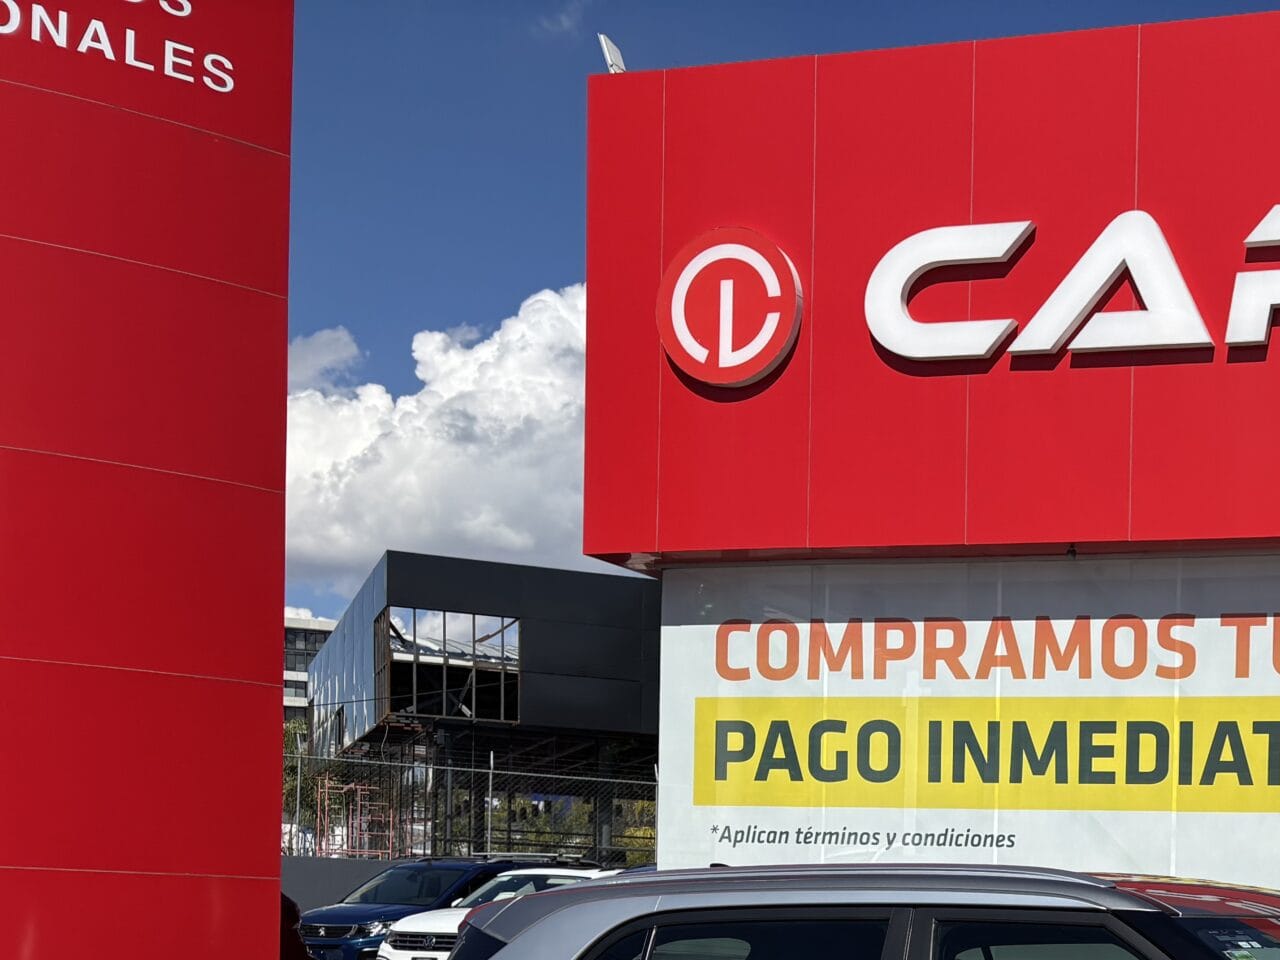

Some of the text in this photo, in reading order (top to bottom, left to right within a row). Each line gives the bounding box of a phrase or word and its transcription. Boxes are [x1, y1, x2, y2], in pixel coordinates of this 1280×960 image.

[714, 612, 1197, 682] COMPRAMOS
[714, 719, 901, 782] PAGO
[795, 826, 881, 846] términos
[885, 831, 896, 850] y
[901, 828, 1016, 848] condiciones
